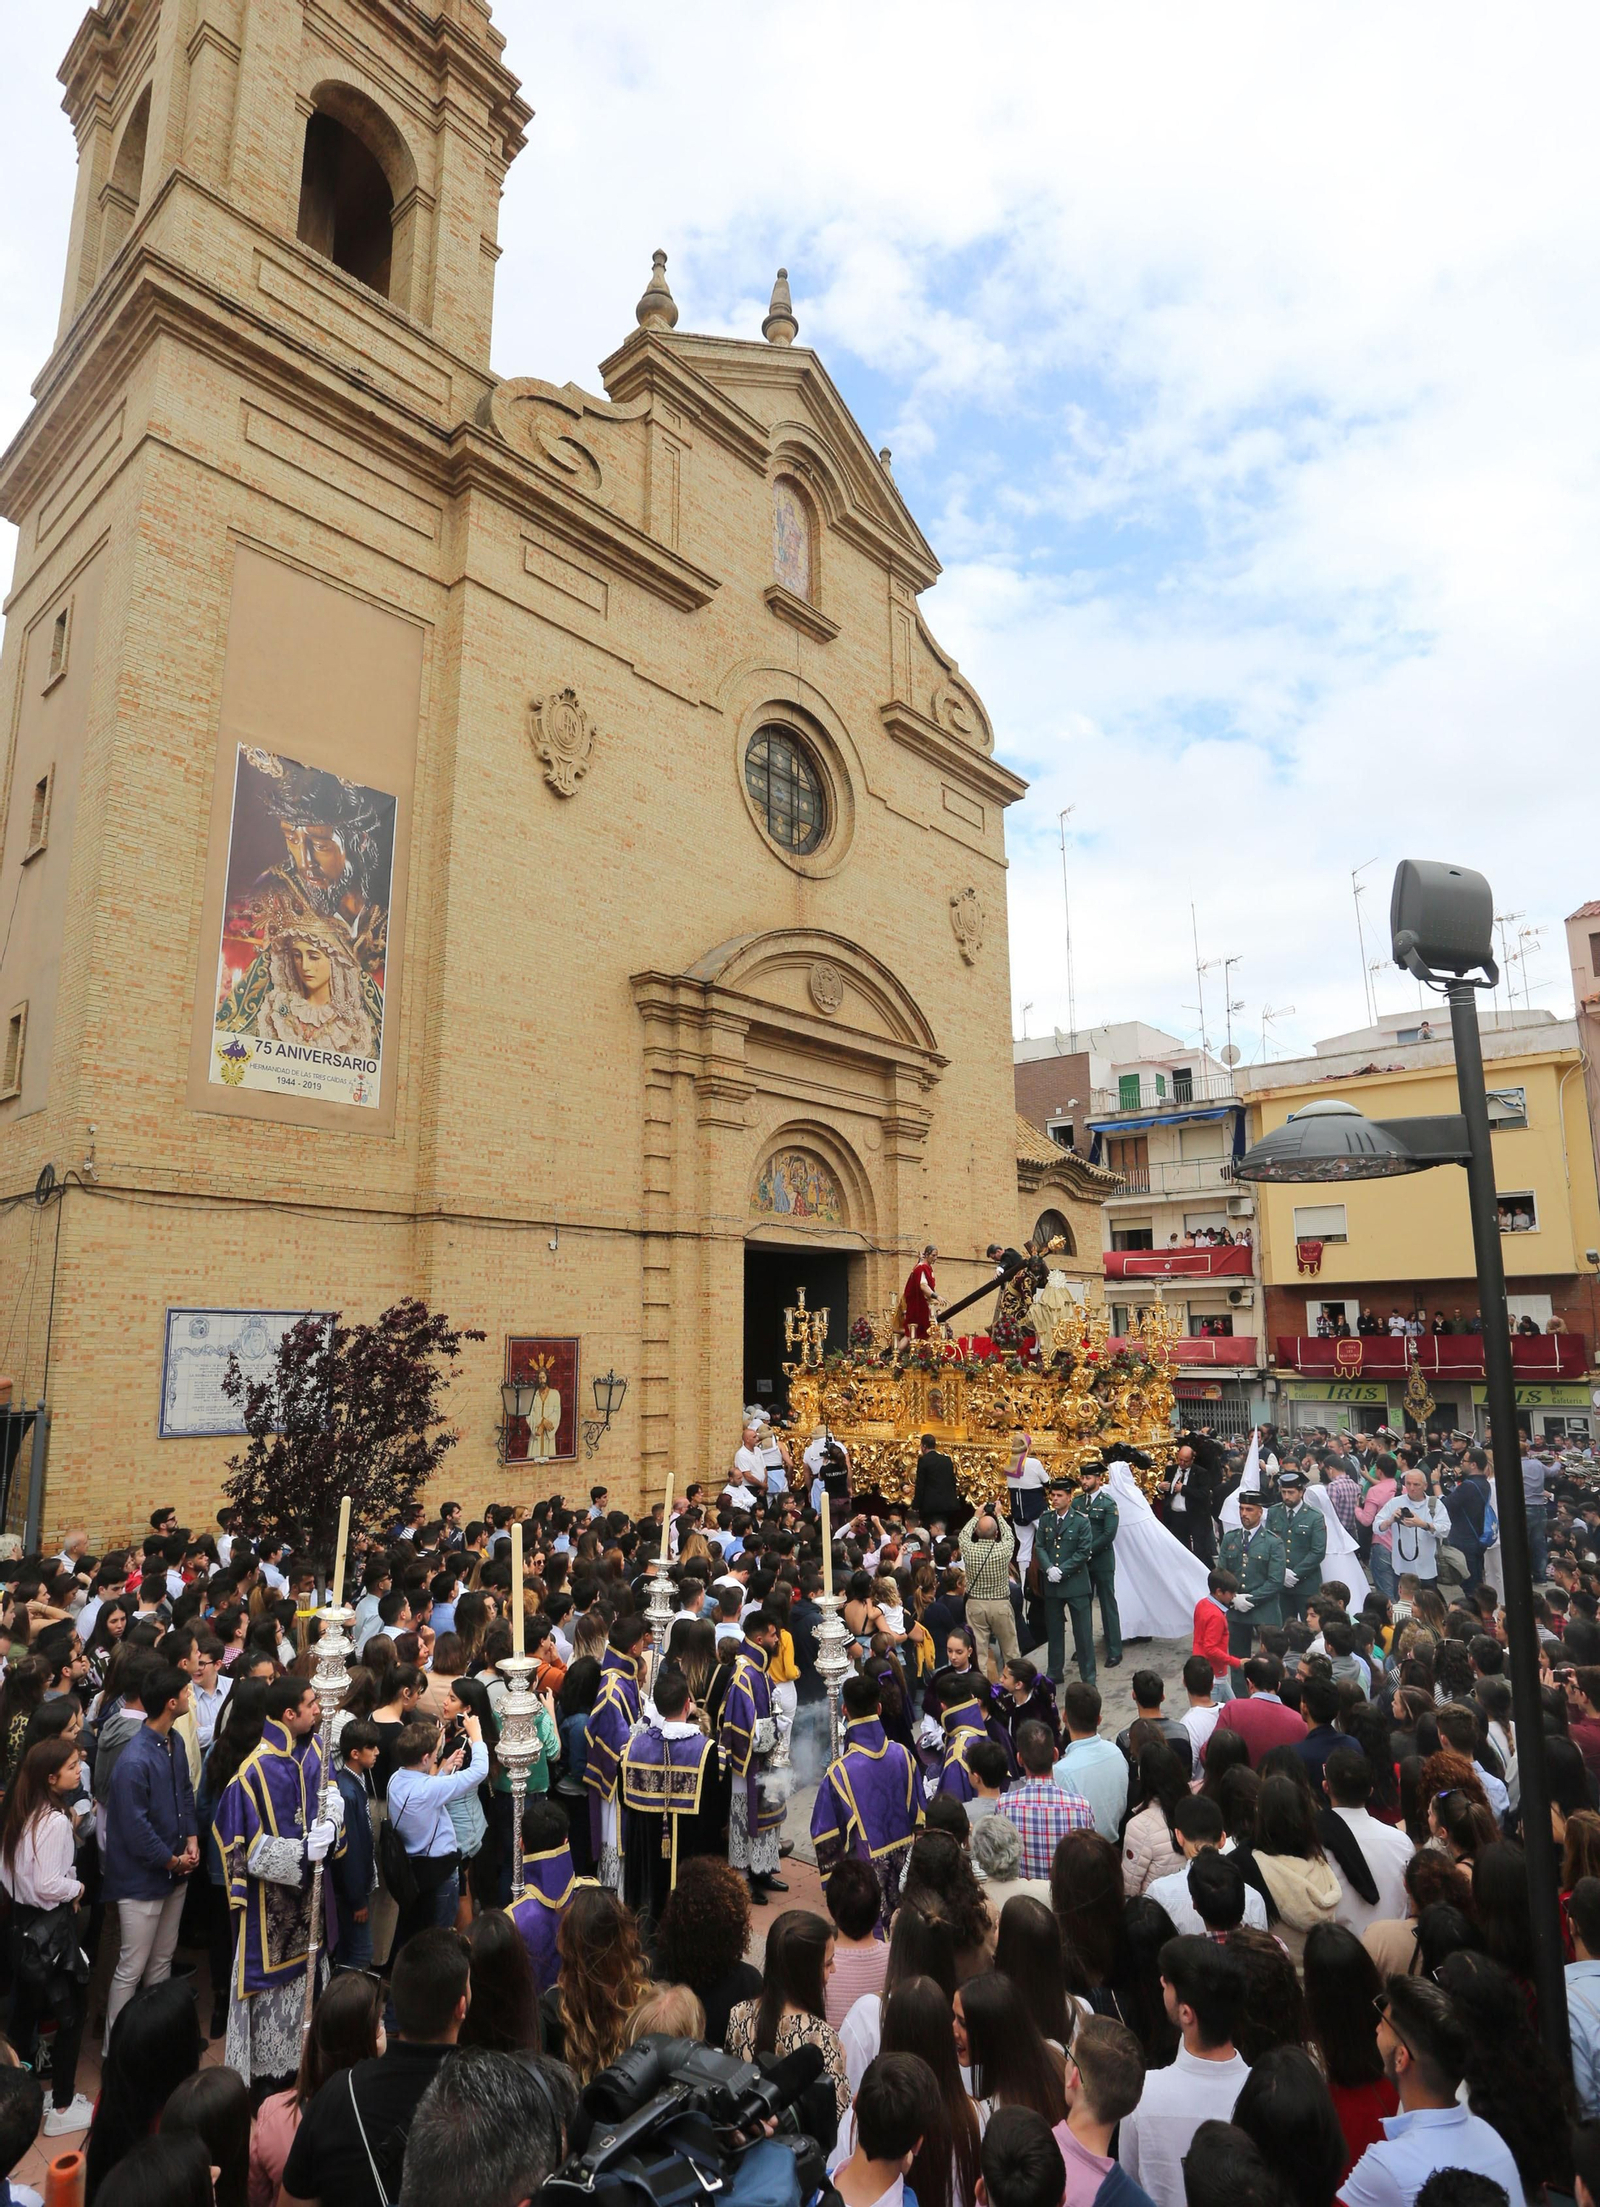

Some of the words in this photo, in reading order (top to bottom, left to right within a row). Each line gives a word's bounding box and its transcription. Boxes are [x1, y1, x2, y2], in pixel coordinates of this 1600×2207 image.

[254, 1039, 272, 1055] 75
[275, 1043, 377, 1073] ANIVERSARIO
[249, 1062, 290, 1075] HERMANDAD
[291, 1069, 300, 1077] DE
[301, 1070, 312, 1079] LAS
[313, 1072, 326, 1081] TRES
[277, 1076, 296, 1086] 1944
[302, 1081, 322, 1091] 2019
[1327, 1385, 1378, 1400] IRIS
[1552, 1397, 1583, 1405] Cafeteria
